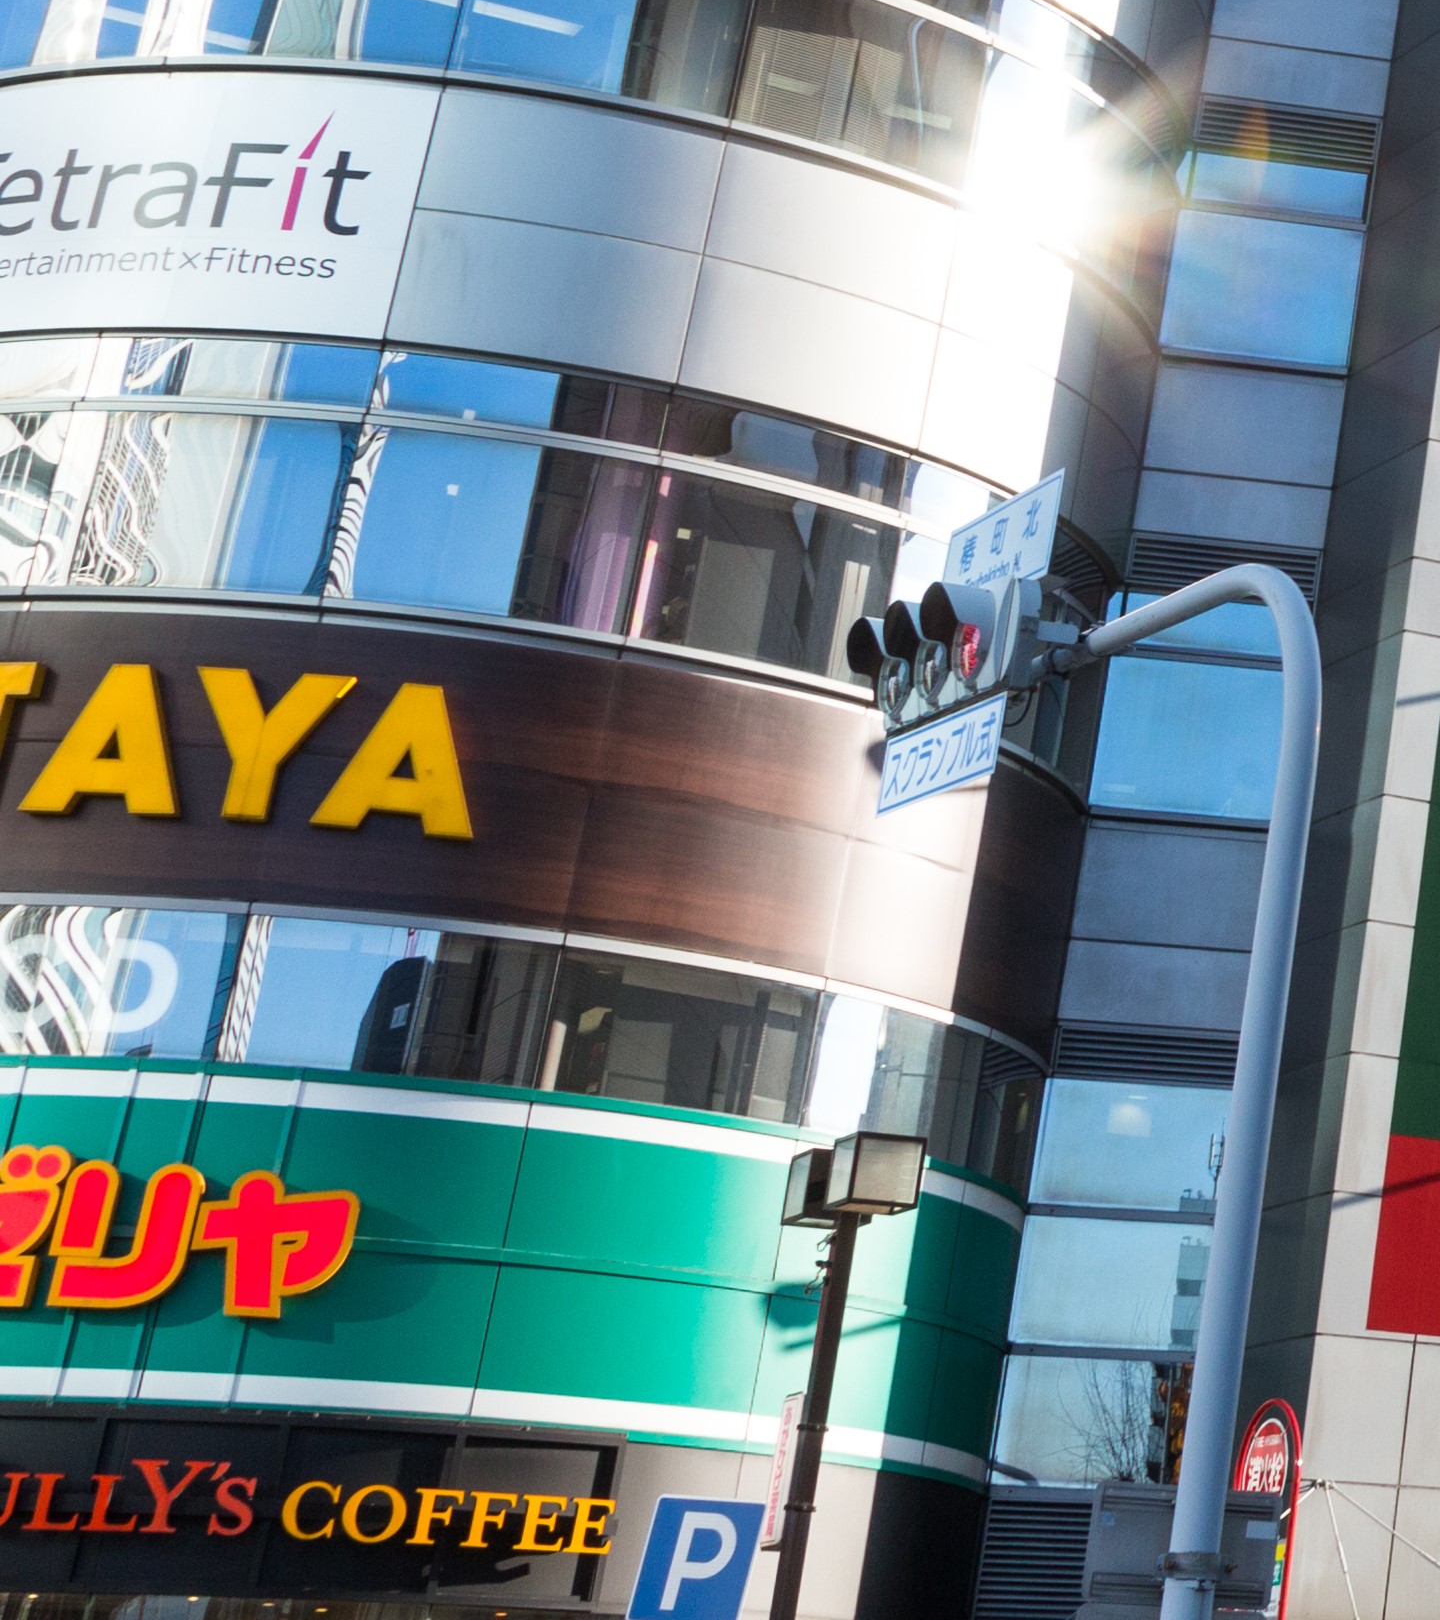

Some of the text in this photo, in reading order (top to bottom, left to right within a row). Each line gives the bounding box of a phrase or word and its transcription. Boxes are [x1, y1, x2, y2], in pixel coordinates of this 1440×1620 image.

[0, 109, 372, 236] etraFit
[884, 711, 997, 799] スクランブル式
[1248, 1451, 1286, 1492] 消火栓
[281, 1480, 618, 1556] COFFEE
[659, 1511, 739, 1612] P
